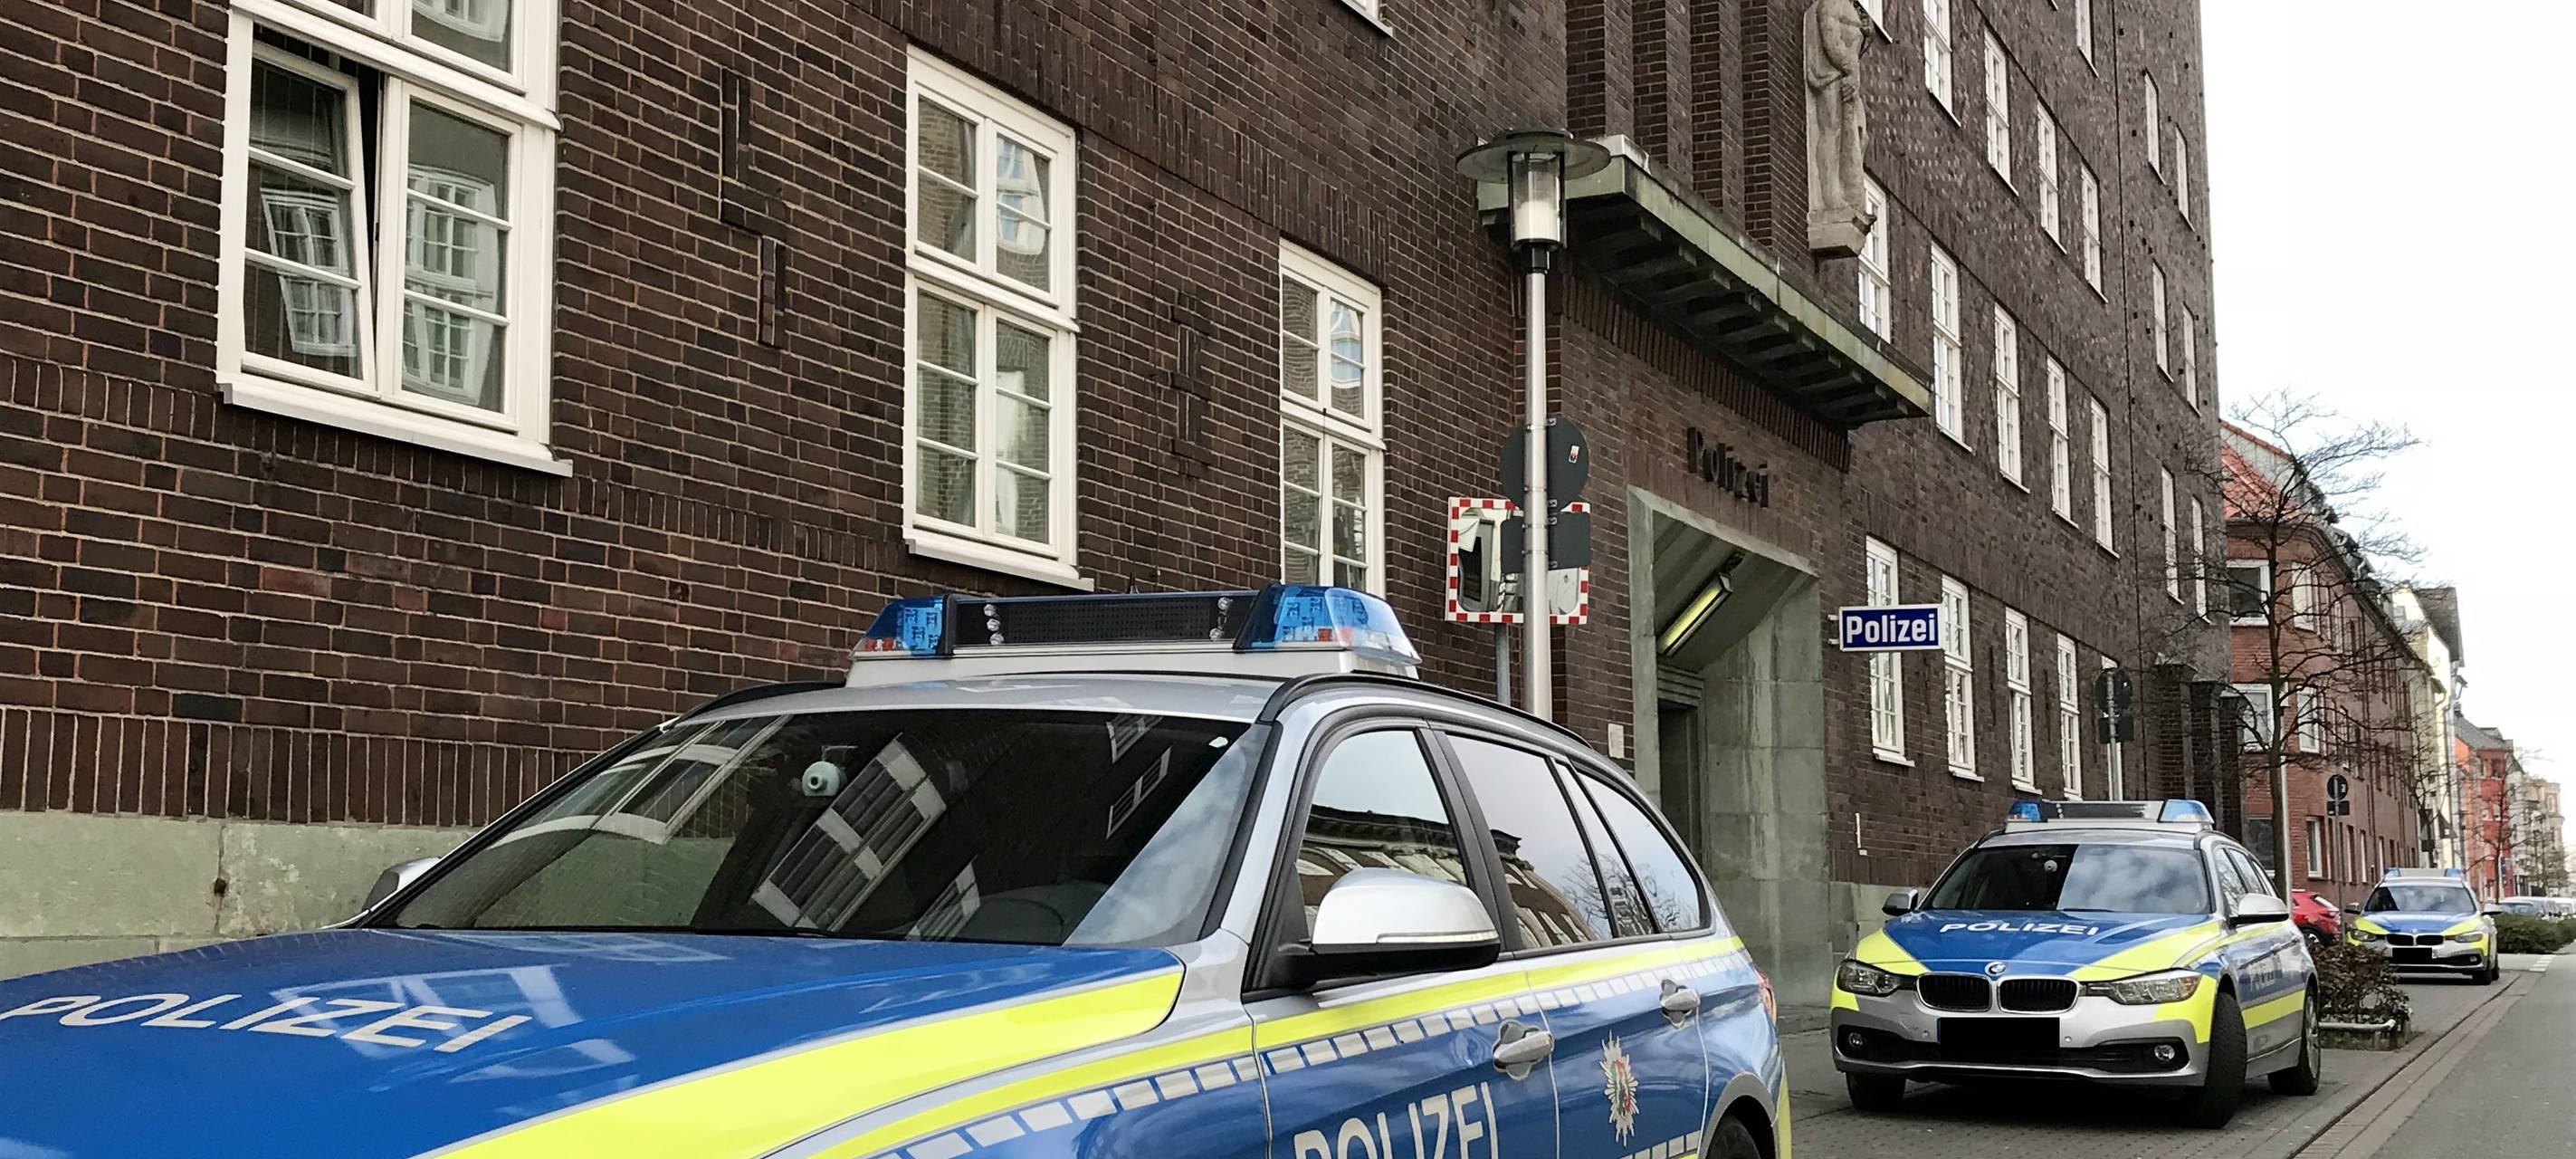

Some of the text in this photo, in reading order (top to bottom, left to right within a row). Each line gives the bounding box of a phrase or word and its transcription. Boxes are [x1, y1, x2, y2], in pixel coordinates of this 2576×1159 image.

[1686, 426, 1769, 508] Polizei
[1846, 613, 1935, 644] Polizei
[1939, 922, 2100, 936] POLIZEI
[0, 993, 532, 1053] POLIZEI
